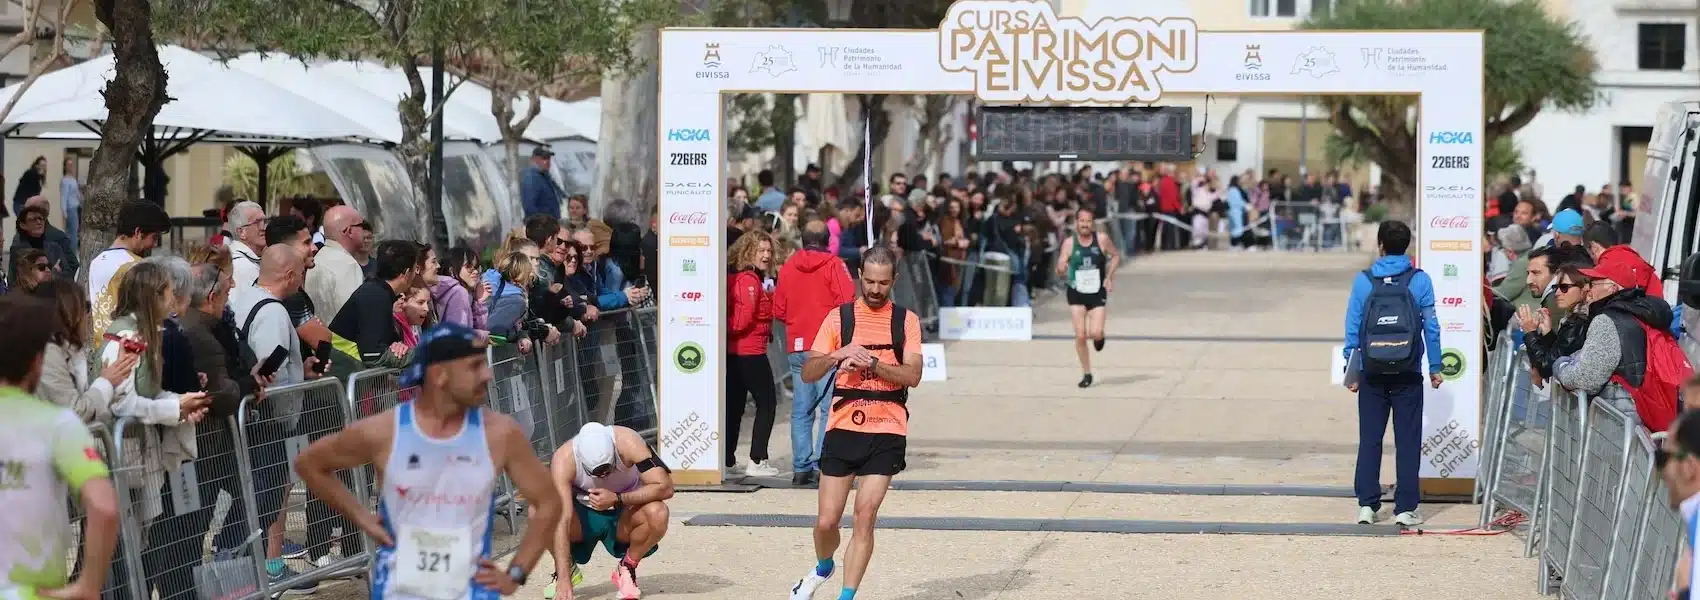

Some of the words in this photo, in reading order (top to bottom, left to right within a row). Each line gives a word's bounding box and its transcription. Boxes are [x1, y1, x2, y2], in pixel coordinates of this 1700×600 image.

[957, 10, 1050, 31] CURSA
[843, 46, 875, 54] Ciudades
[951, 28, 1186, 61] PATRIMONI
[762, 56, 774, 66] 25
[1303, 57, 1316, 67] 25
[695, 70, 730, 79] eivissa
[986, 60, 1150, 91] EIVISSA
[1235, 71, 1271, 81] eivissa
[668, 128, 711, 141] HOKA
[1429, 131, 1473, 144] HOKA
[670, 152, 707, 165] 226ERS
[1431, 155, 1470, 168] 226ERS
[681, 291, 701, 302] cap
[660, 410, 700, 448] #ibiza
[671, 421, 709, 460] rompe
[1420, 419, 1460, 457] #ibiza
[681, 430, 720, 470] elmuro
[1429, 429, 1470, 469] rompe
[1439, 439, 1480, 479] elmuro
[416, 550, 451, 573] 321
